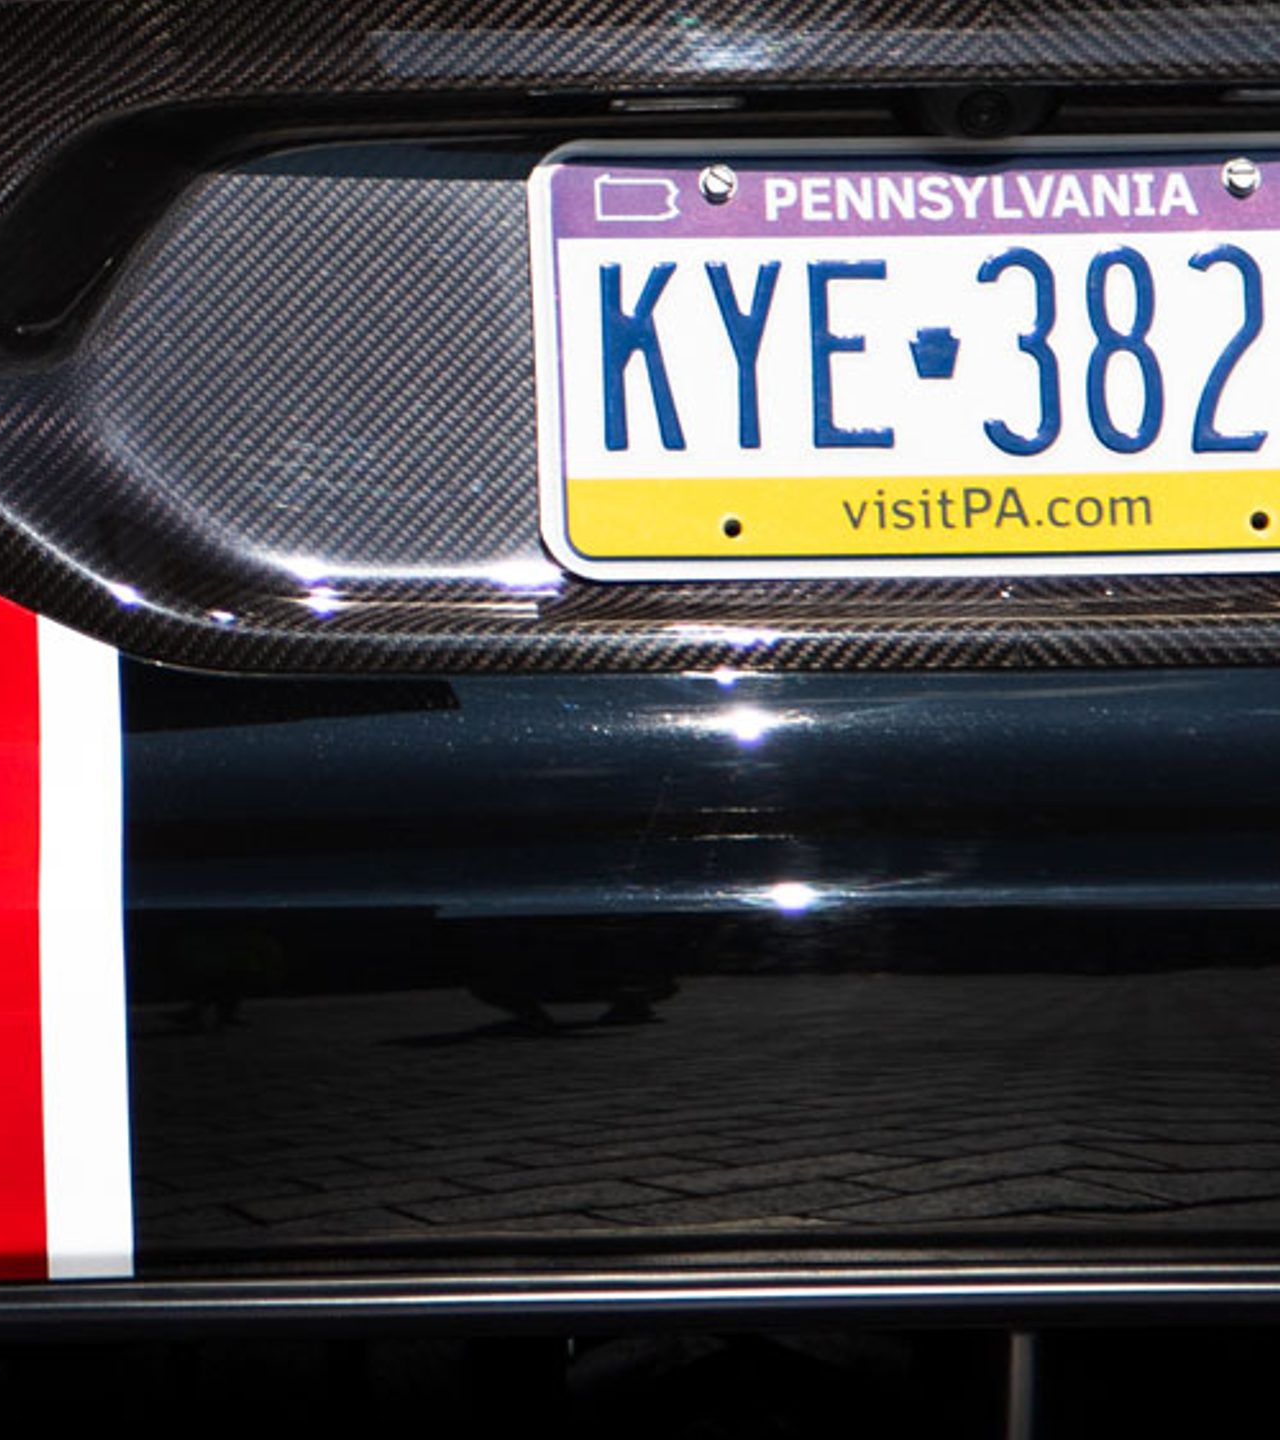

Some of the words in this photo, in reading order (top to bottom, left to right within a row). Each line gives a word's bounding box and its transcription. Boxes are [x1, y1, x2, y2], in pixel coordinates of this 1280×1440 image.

[765, 174, 1198, 221] PENNSYLVANIA
[598, 259, 895, 451] KYE
[976, 243, 1268, 457] 382
[842, 487, 1153, 531] visitPA.com
